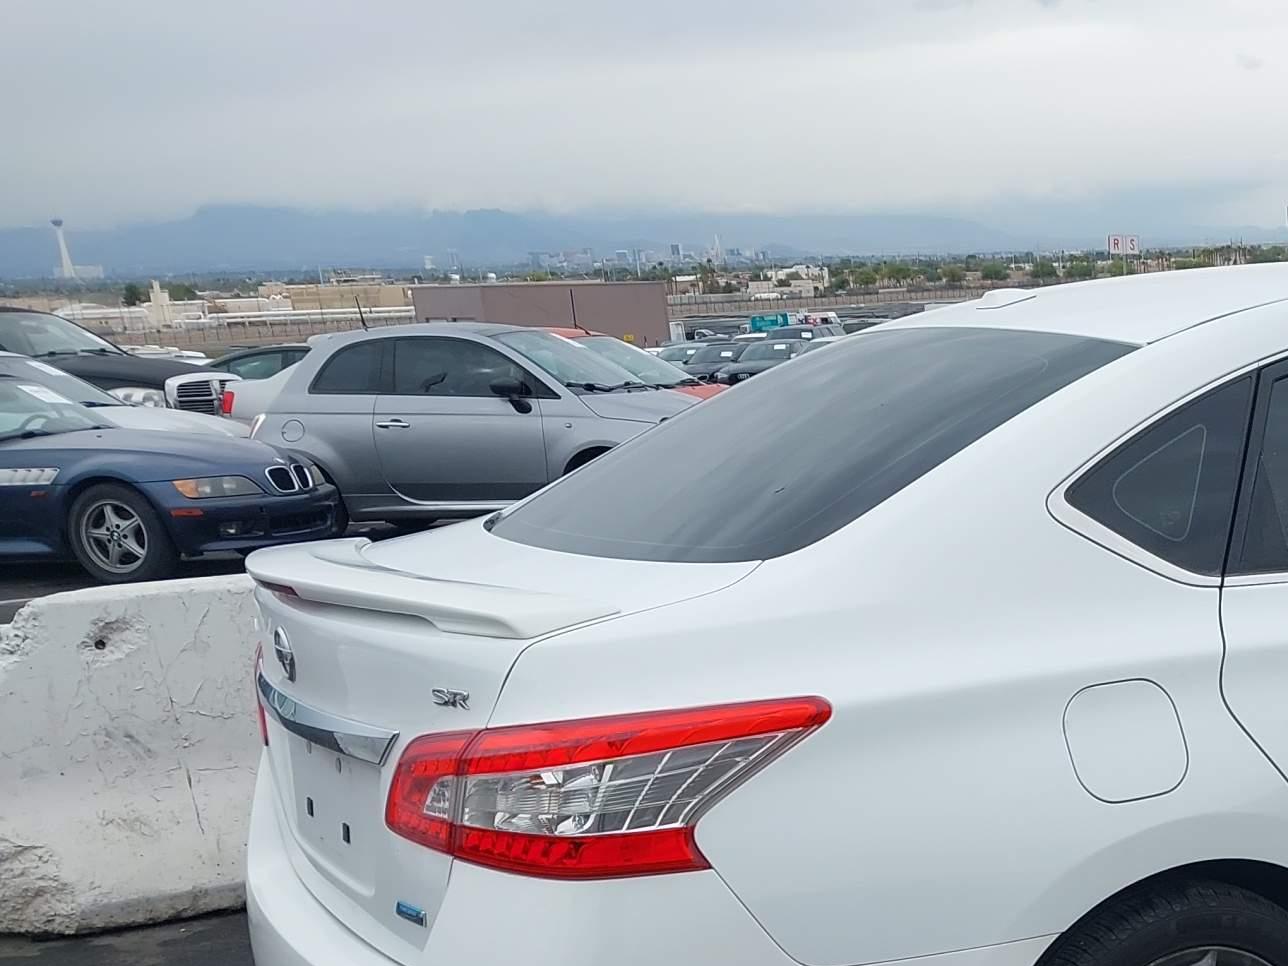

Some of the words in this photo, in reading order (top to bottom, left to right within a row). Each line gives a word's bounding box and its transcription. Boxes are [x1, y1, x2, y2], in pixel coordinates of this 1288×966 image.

[1113, 238, 1120, 251] R
[1129, 238, 1136, 251] S
[431, 687, 471, 711] SR
